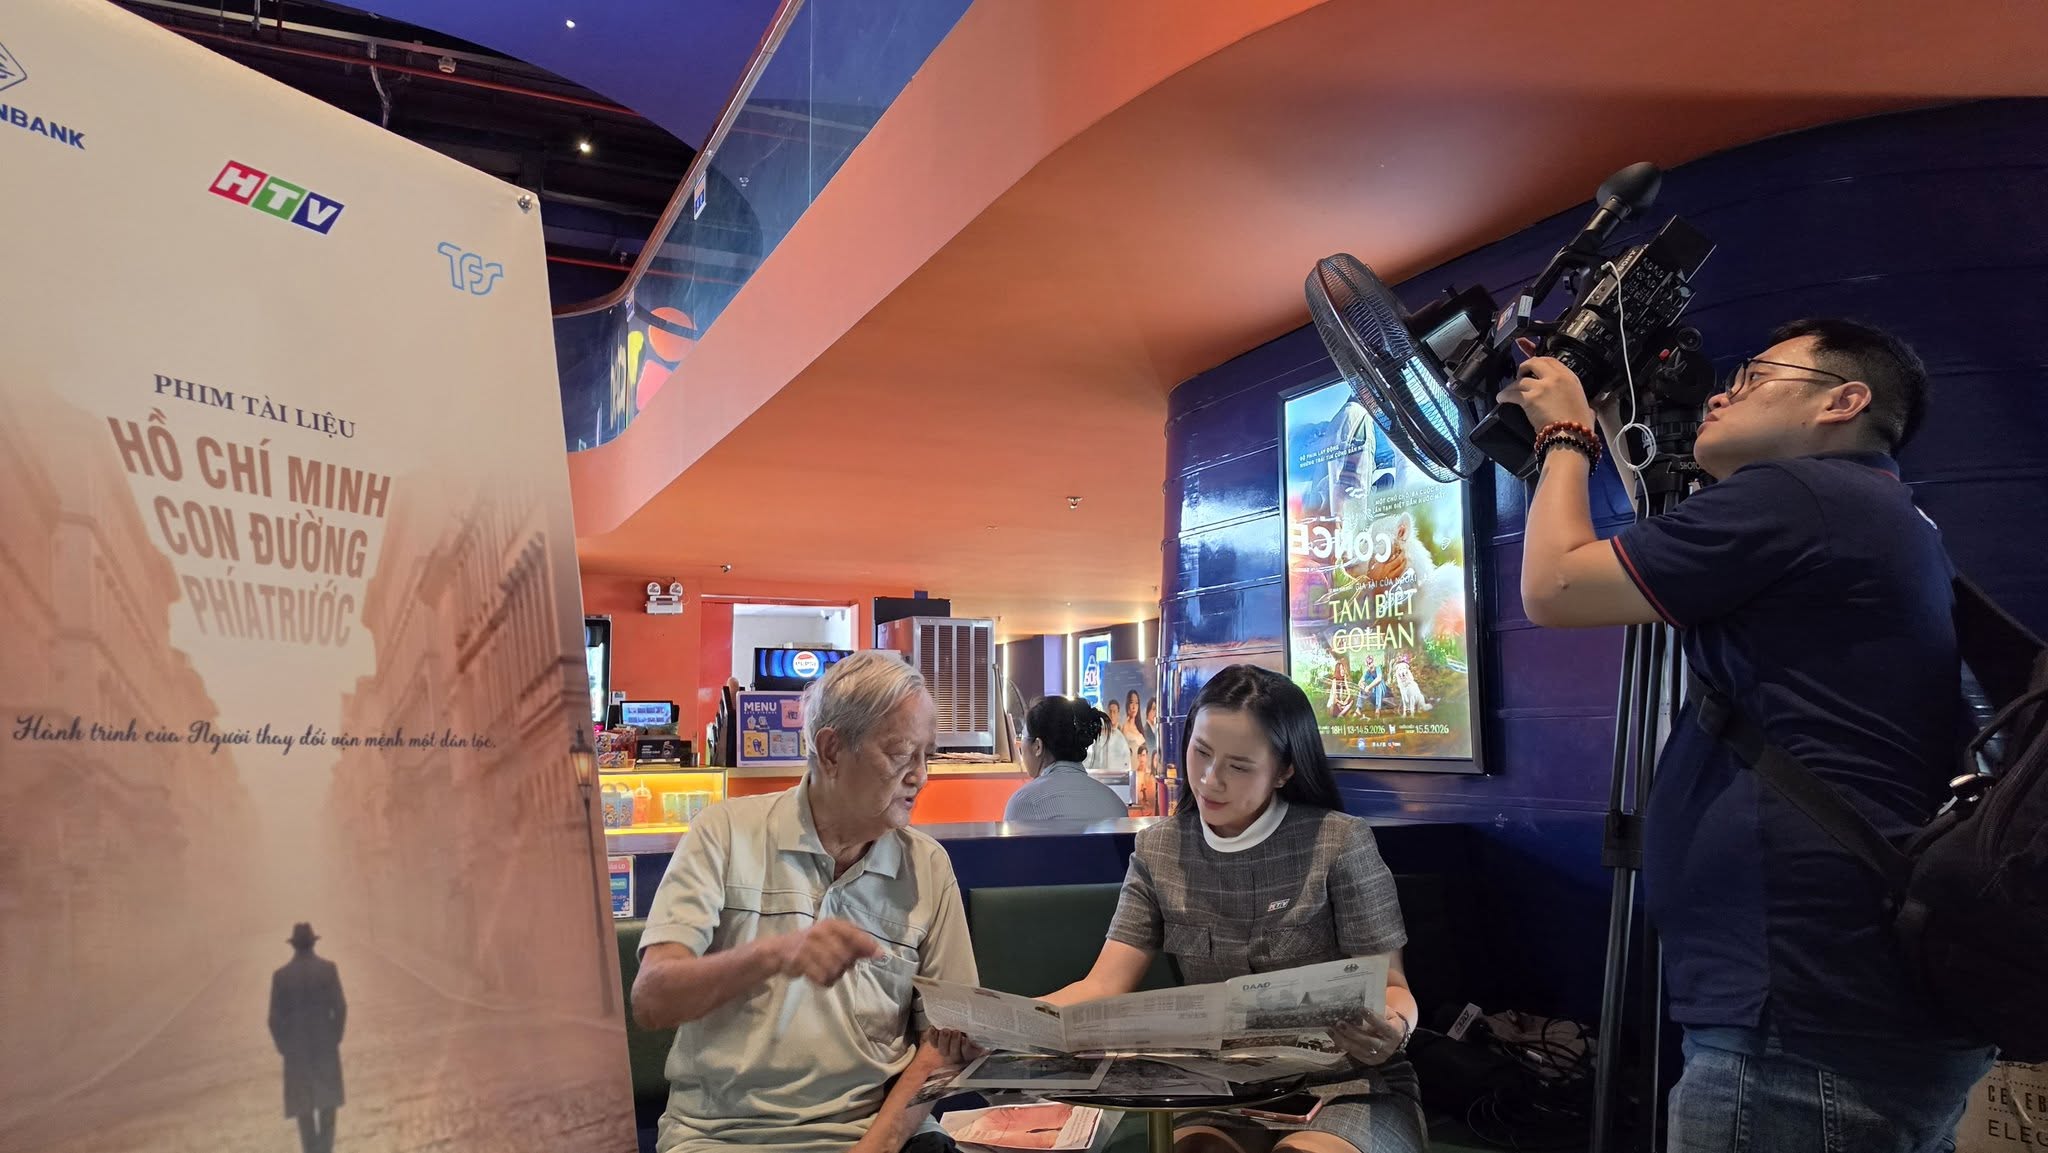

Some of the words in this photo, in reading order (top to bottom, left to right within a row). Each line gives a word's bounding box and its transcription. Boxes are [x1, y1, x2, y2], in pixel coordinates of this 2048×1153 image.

[212, 164, 340, 229] HTV
[154, 373, 235, 411] PHIM
[241, 395, 288, 423] TÀI
[295, 408, 356, 439] LIỆU
[107, 407, 183, 482] HỒ
[196, 437, 273, 498] CHÍ
[287, 454, 392, 518] MINH
[153, 494, 241, 562] CON
[248, 508, 369, 579] ĐƯỜNG
[1328, 595, 1370, 627] TẠM
[1375, 587, 1418, 621] BIỆT
[1332, 621, 1415, 654] GOHAN
[744, 701, 777, 712] MENU
[13, 715, 84, 741] Hành
[90, 718, 138, 743] trình
[144, 725, 181, 743] của
[187, 720, 251, 755] Người
[255, 723, 296, 756] thay
[299, 724, 328, 746] đổi
[331, 732, 362, 750] vận
[364, 727, 405, 751] mệnh
[408, 732, 437, 751] một
[440, 728, 469, 748] dân
[471, 732, 497, 752] tộc.
[1242, 981, 1272, 991] DAAD
[1988, 1084, 2047, 1113] CEEB
